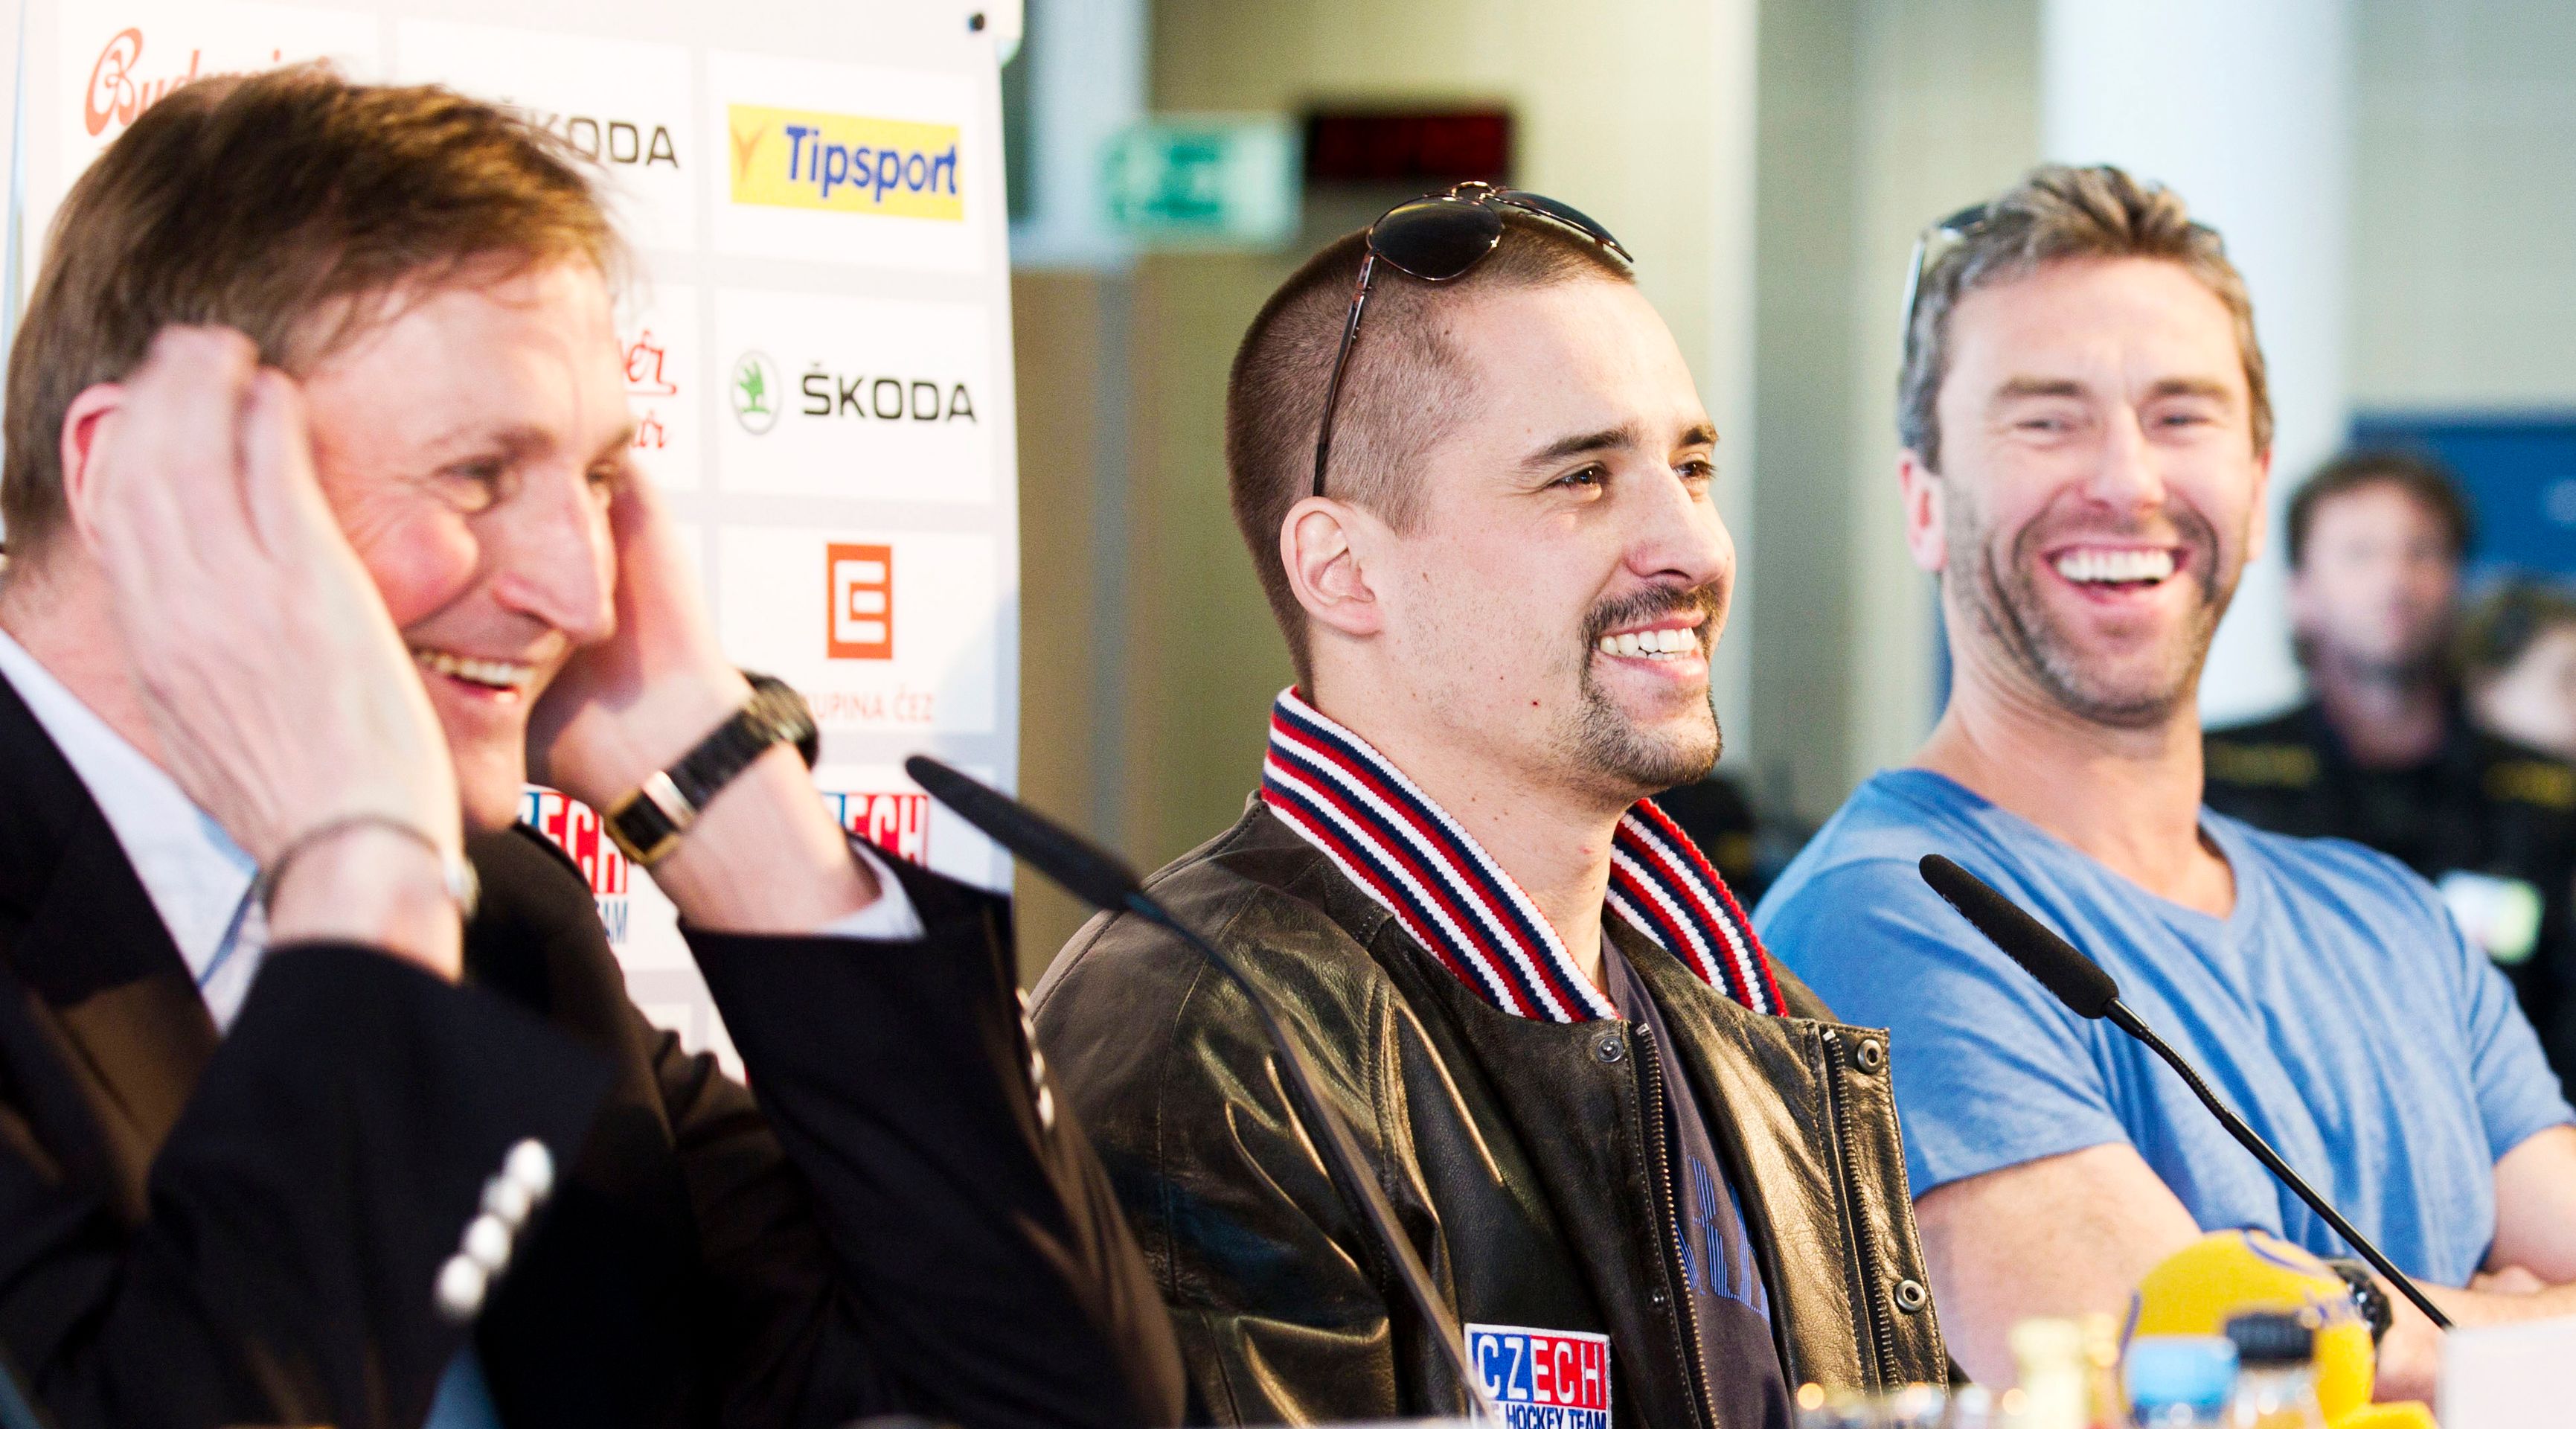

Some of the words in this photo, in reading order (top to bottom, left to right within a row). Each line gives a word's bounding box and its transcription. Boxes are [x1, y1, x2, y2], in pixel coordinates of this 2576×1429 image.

[784, 124, 959, 203] Tipsport
[801, 362, 978, 423] ŠKODA
[1478, 1334, 1602, 1407] CZECH
[1505, 1403, 1564, 1429] HOCKEY
[1568, 1408, 1607, 1429] TEAM
